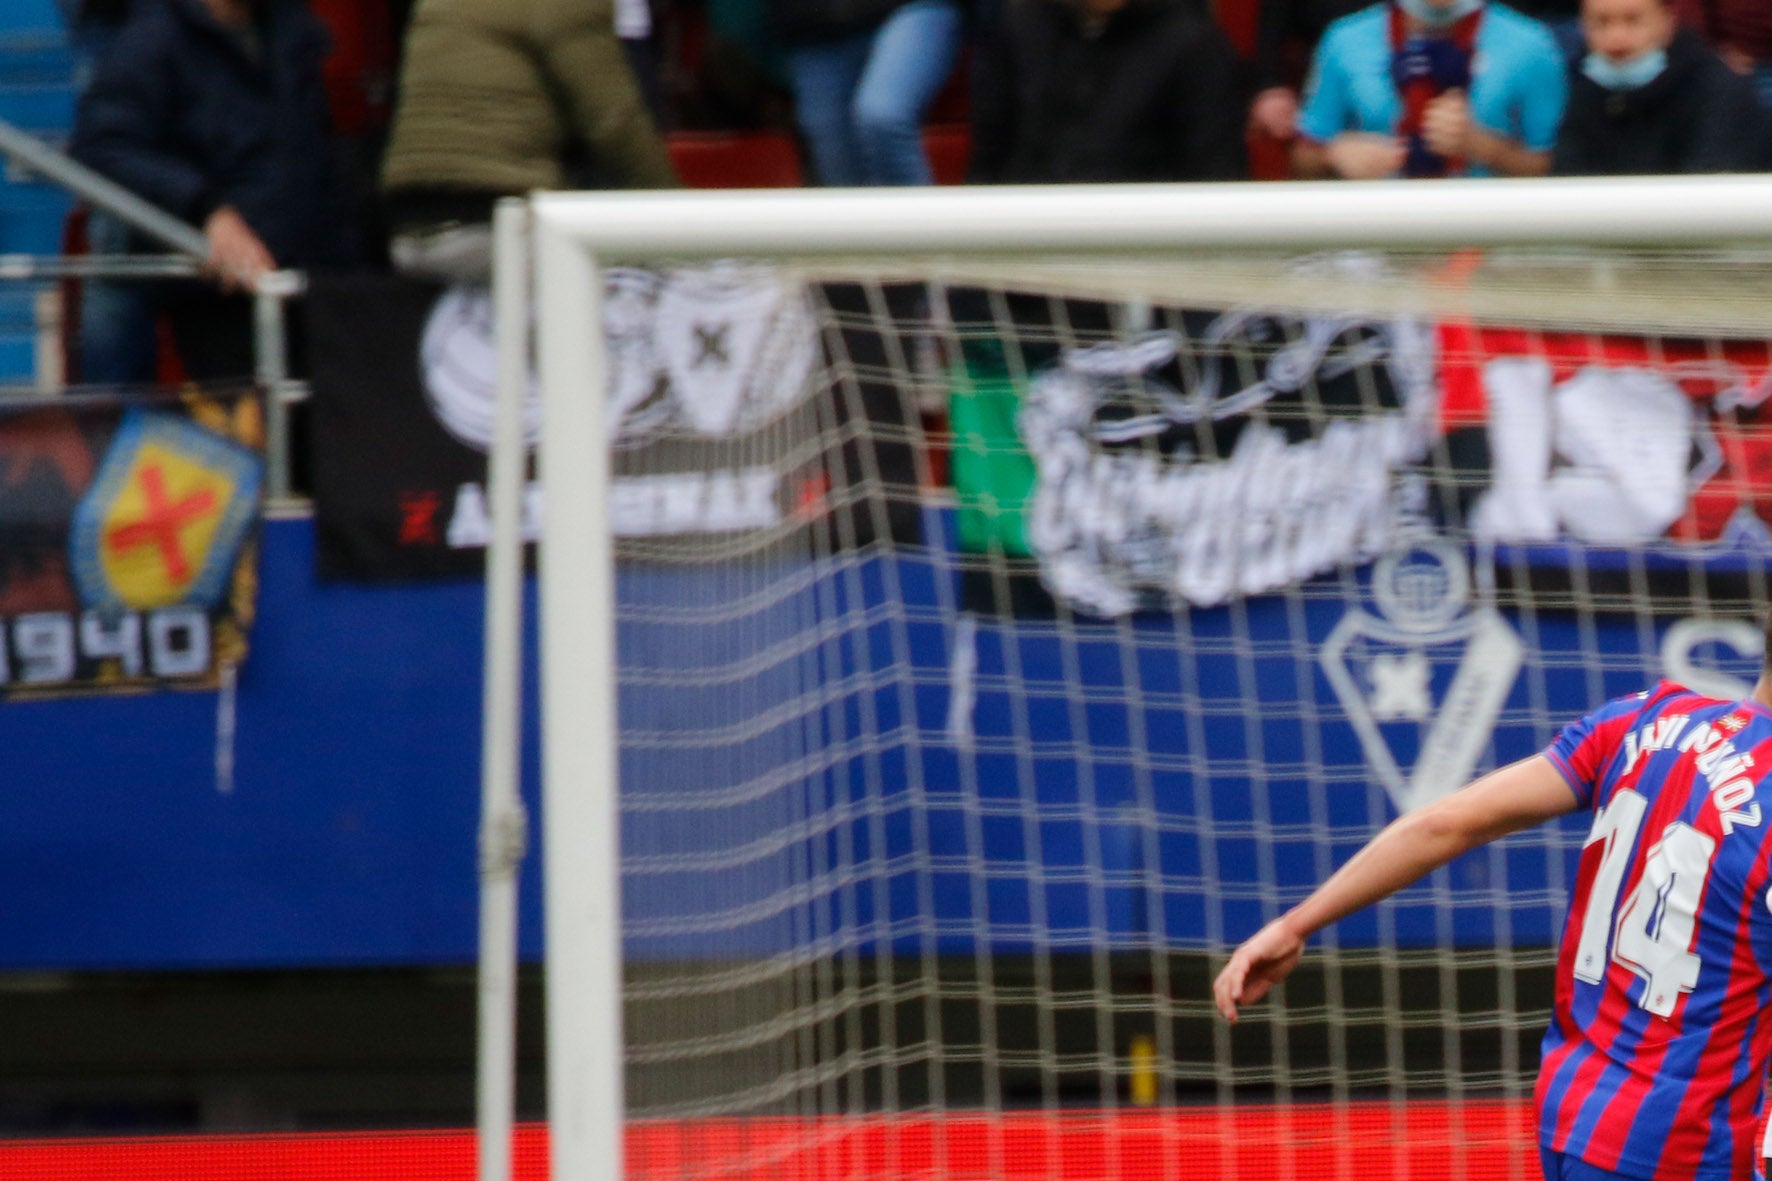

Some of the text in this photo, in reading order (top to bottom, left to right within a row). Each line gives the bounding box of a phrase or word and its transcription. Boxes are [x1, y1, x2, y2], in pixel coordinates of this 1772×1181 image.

[1622, 712, 1763, 836] JAVI MUÑOZ
[1573, 787, 1717, 1018] 14
